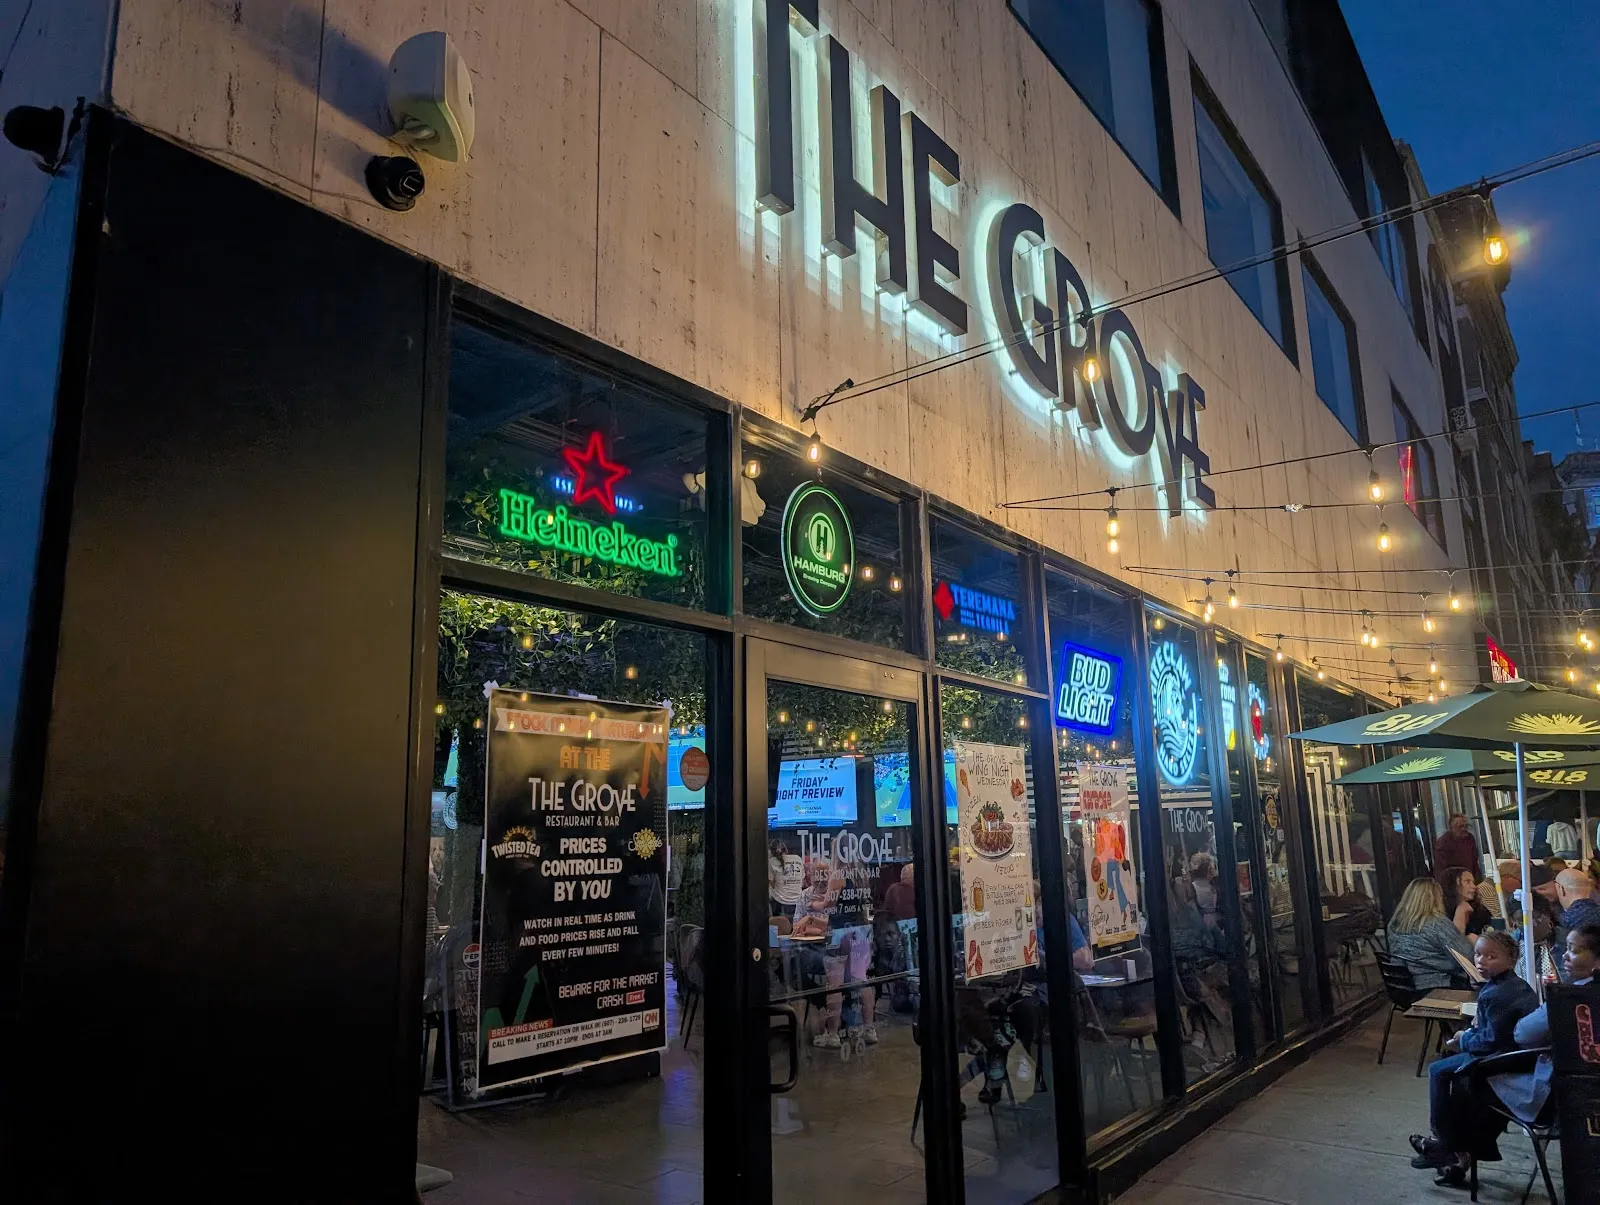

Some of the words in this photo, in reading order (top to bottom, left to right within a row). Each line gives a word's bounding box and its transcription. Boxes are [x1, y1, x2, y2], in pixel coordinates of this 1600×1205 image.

[756, 0, 968, 336] THE
[985, 202, 1216, 518] GROVE
[499, 488, 677, 577] Heineken
[794, 555, 845, 584] HAMBURG
[1071, 652, 1111, 693] BUD
[1058, 683, 1114, 727] LIGHT
[506, 711, 547, 731] STOCK
[1366, 712, 1449, 731] 818
[560, 745, 580, 769] AT
[584, 747, 612, 771] THE
[968, 763, 988, 776] WING
[1529, 769, 1588, 782] 818
[791, 776, 824, 788] FRIDAY
[529, 778, 565, 811] THE
[571, 780, 636, 816] GROVE
[802, 787, 844, 799] PREVIEW
[545, 816, 596, 827] RESTAURANT
[597, 816, 602, 827] &
[604, 816, 620, 827] BAR
[1168, 808, 1184, 832] THE
[491, 841, 526, 858] TWISTED
[526, 841, 541, 858] TEA
[560, 838, 607, 854] PRICES
[797, 830, 830, 864] THE
[836, 829, 894, 868] GROVE
[541, 858, 623, 877] CONTROLLED
[554, 881, 575, 902] BY
[580, 879, 612, 900] YOU
[524, 918, 552, 930] WATCH
[554, 917, 562, 927] IN
[564, 916, 583, 926] REAL
[584, 914, 602, 924] TIME
[604, 913, 613, 923] AS
[614, 911, 636, 922] DRINK
[520, 936, 536, 947] AND
[538, 934, 559, 945] FOOD
[561, 931, 587, 942] PRICES
[589, 929, 606, 940] RISE
[607, 927, 621, 938] AND
[623, 925, 639, 936] FALL
[542, 949, 566, 961] EVERY
[568, 947, 584, 958] FEW
[586, 943, 620, 956] MINUTES!
[559, 982, 592, 999] BEWARE
[594, 979, 610, 993] FOR
[612, 976, 628, 990] THE
[629, 972, 659, 988] MARKET
[597, 994, 624, 1010] CRASH
[630, 994, 641, 1002] Free
[644, 1012, 658, 1024] CNN
[491, 1023, 528, 1038] BREAKING
[528, 1020, 549, 1031] NEWS
[492, 1041, 506, 1049] CALL
[507, 1038, 514, 1046] TO
[515, 1035, 531, 1044] MAKE
[537, 1028, 571, 1040] RESERVATION
[580, 1023, 594, 1031] WALK
[536, 1041, 555, 1050] STARTS
[581, 1032, 594, 1041] ENDS
[595, 1030, 602, 1038] AT
